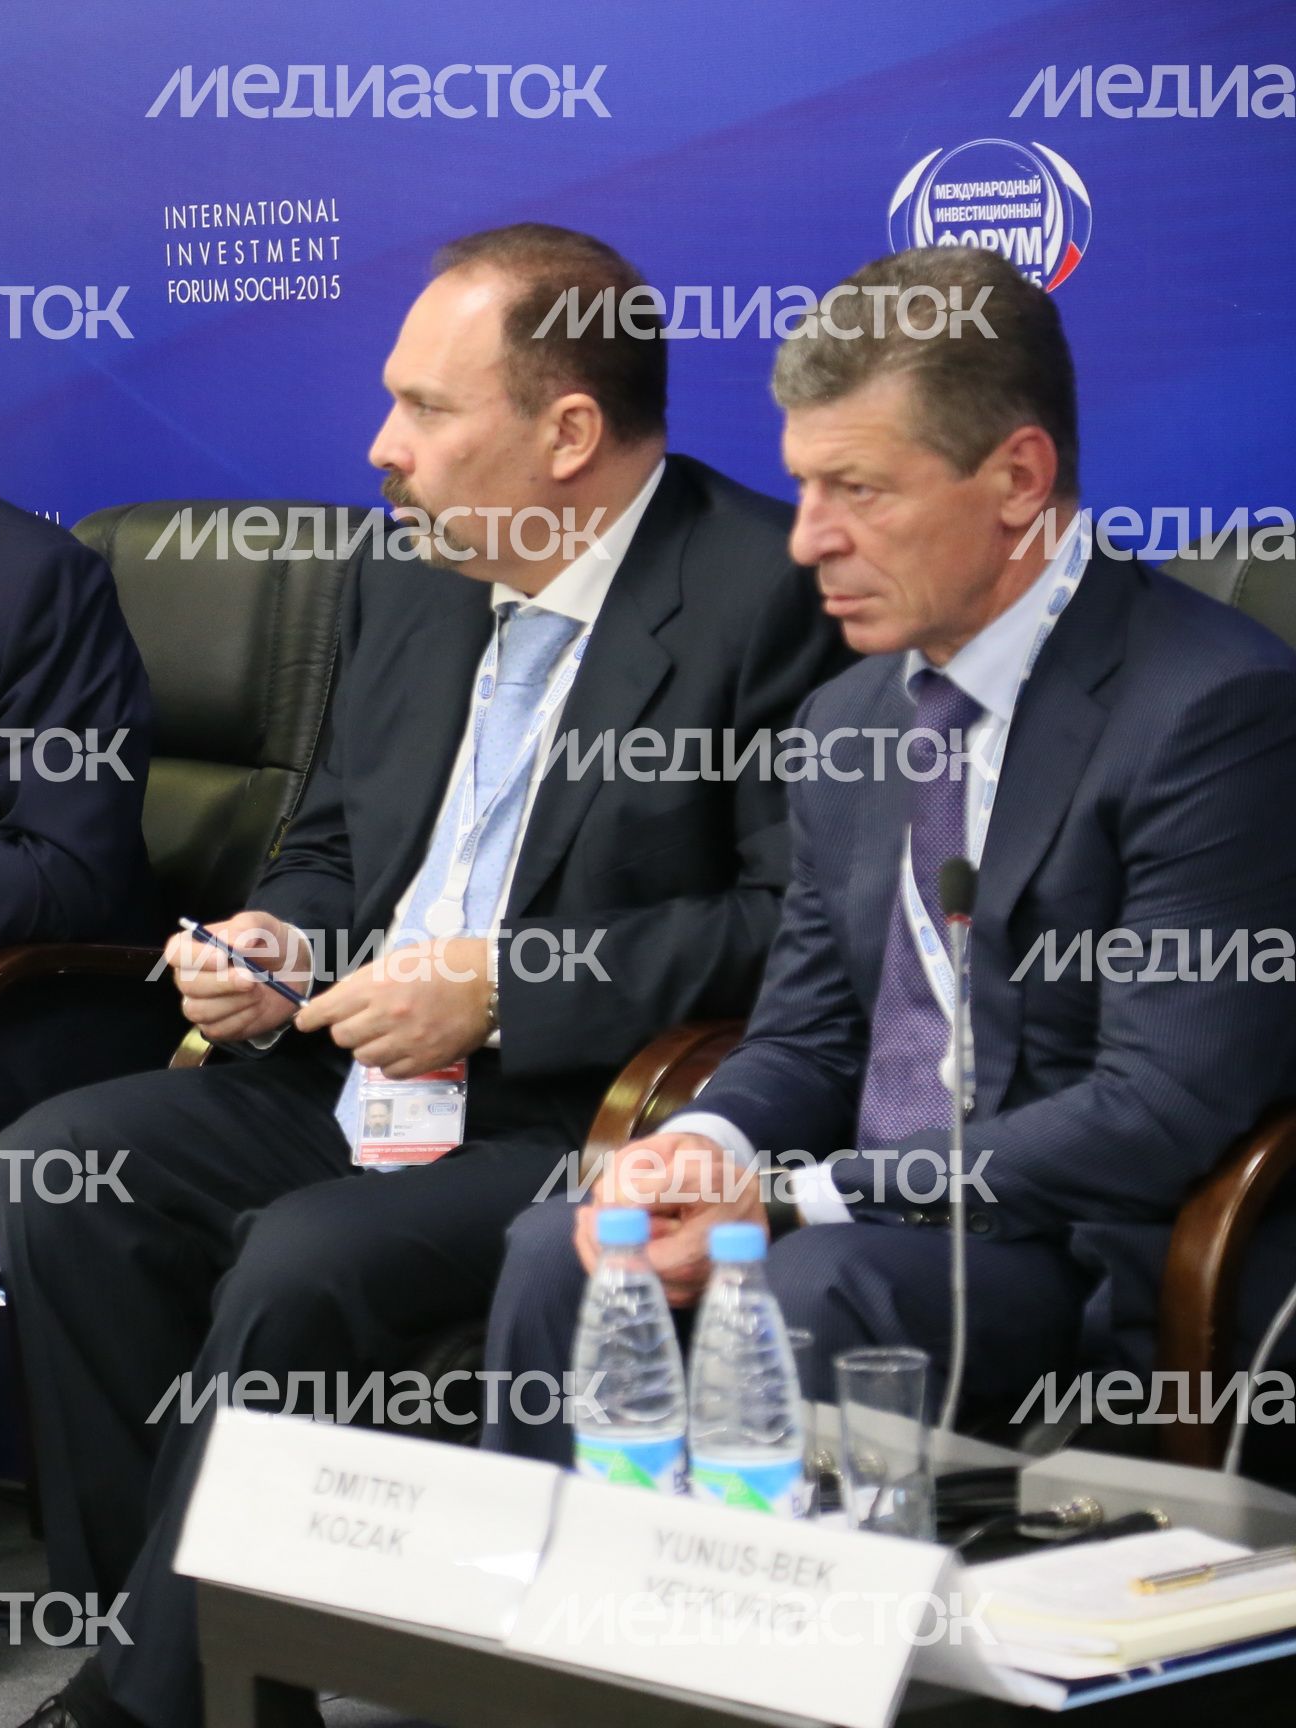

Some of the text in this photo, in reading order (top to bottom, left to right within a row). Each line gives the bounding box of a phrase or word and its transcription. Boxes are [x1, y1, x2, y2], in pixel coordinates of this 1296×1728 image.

[934, 174, 1042, 201] МЕЖДУНАРОДНЫЙ
[164, 198, 340, 230] INTERNATIONAL
[935, 198, 1042, 223] ИНВЕСТИЦИОННЫЙ
[166, 236, 341, 267] INVESTMENT
[168, 275, 341, 304] FORUM SOCHI-2015
[313, 1466, 427, 1514] DMITRY
[307, 1511, 411, 1557] KOZAK
[655, 1528, 838, 1591] YUNUS-BEK
